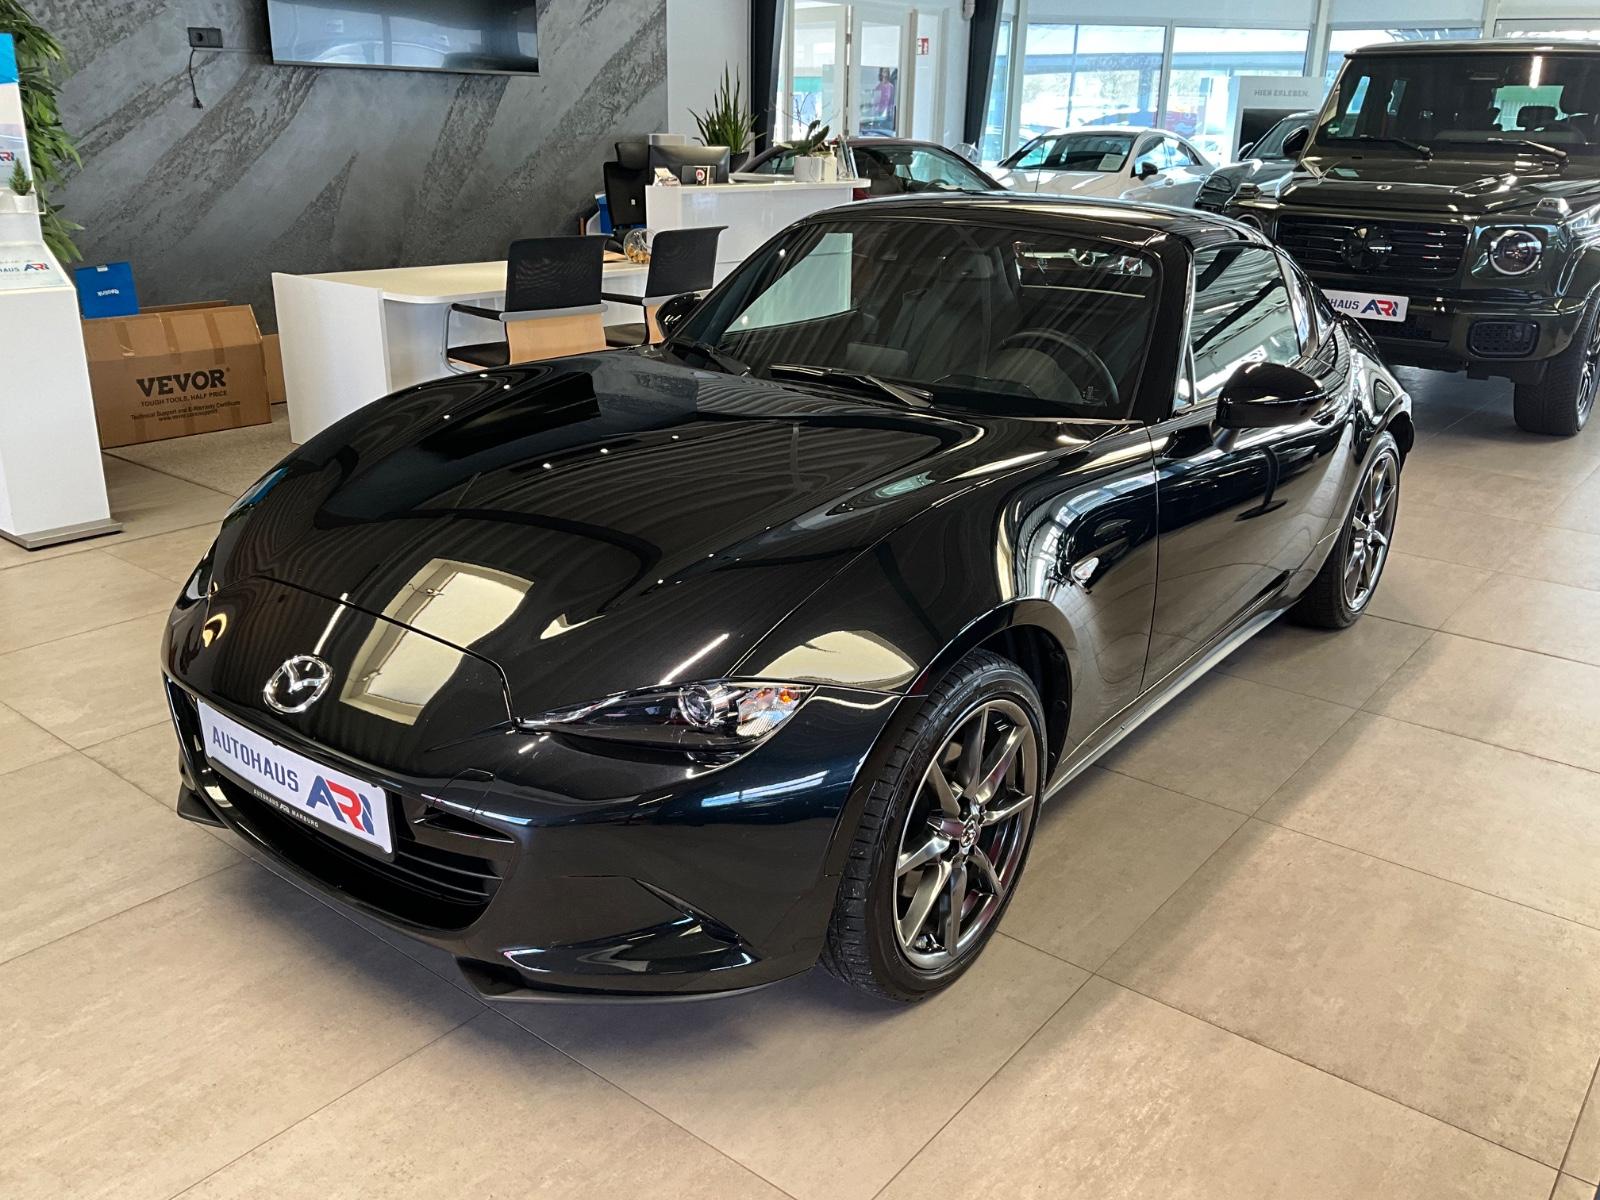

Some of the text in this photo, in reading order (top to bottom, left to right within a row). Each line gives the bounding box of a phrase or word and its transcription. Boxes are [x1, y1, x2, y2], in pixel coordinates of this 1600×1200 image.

[24, 262, 50, 271] ARI
[1328, 298, 1399, 317] HAUS ARI
[136, 369, 226, 397] VEVOR
[141, 399, 165, 408] TOUGH
[190, 393, 207, 401] HALF
[209, 390, 227, 398] PRICE
[212, 726, 375, 836] AUTOHAUS ARI
[253, 788, 279, 807] AUTOHAUS
[291, 809, 319, 828] MARBURG
